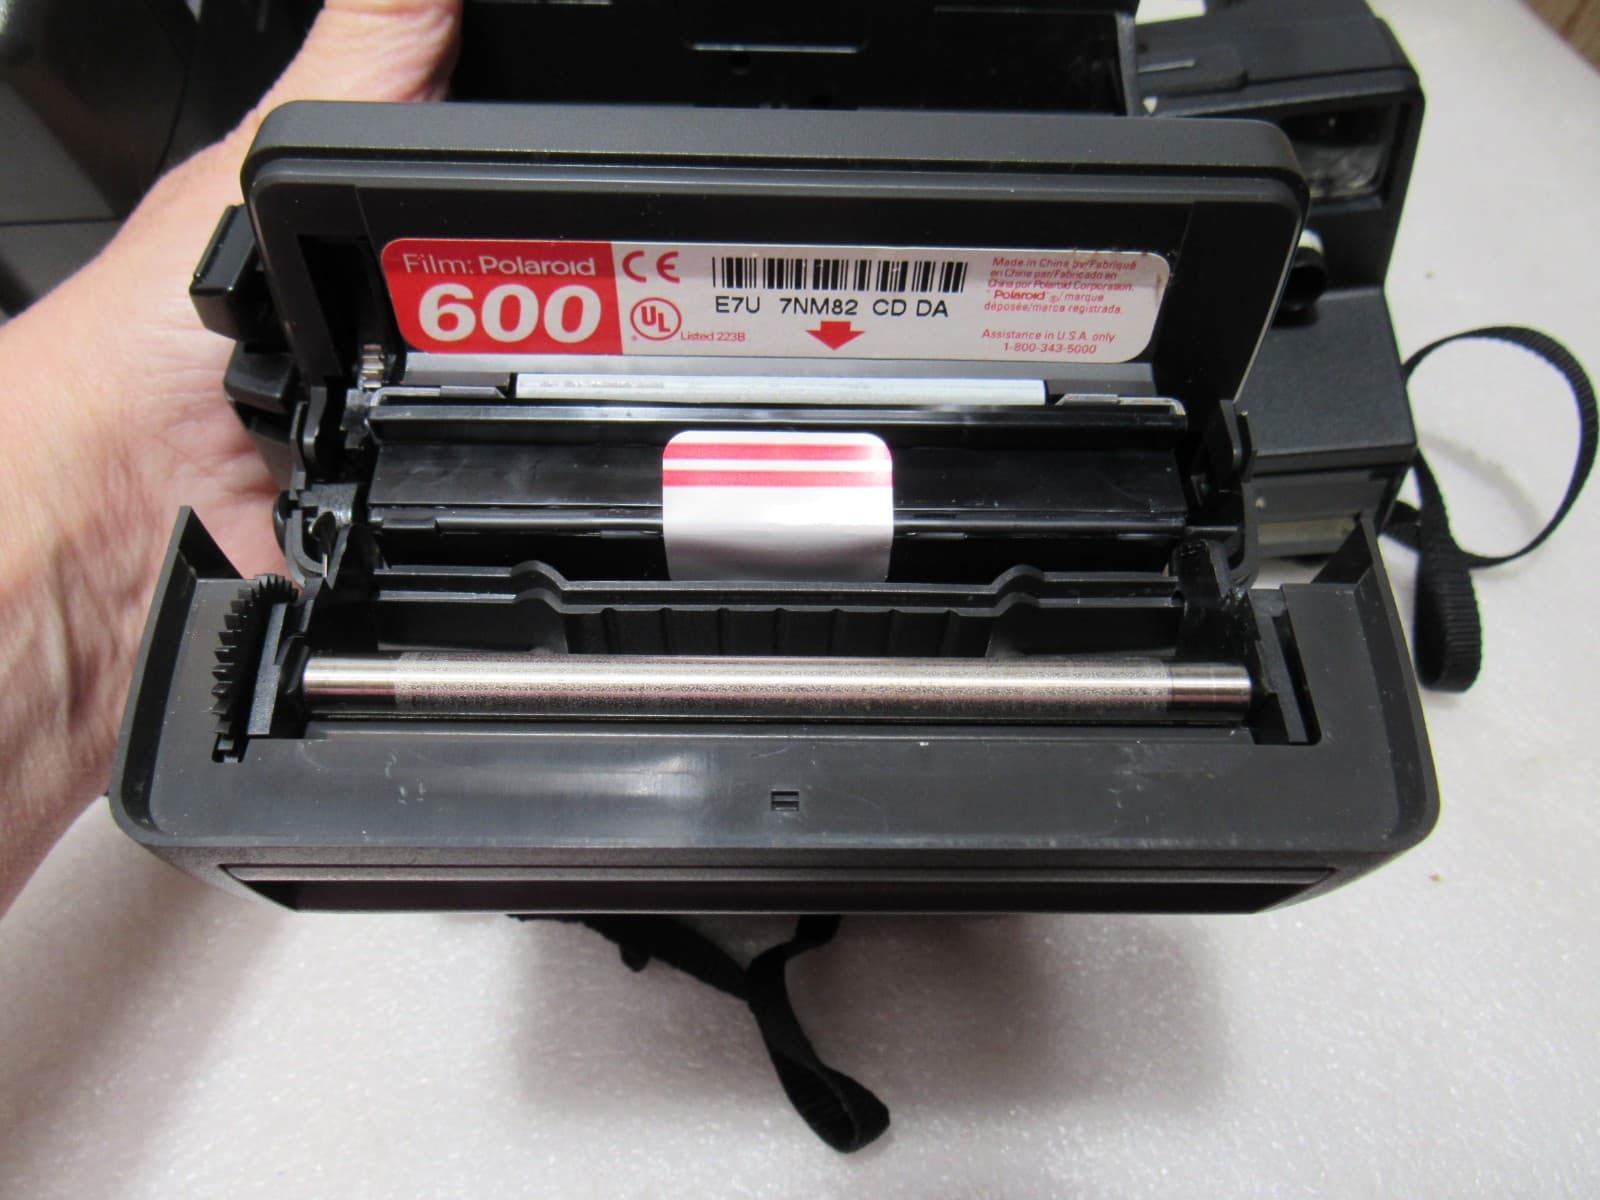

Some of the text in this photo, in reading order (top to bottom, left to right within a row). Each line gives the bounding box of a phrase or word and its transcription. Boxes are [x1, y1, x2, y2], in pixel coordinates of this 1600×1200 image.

[402, 253, 596, 276] Film: Polaroid
[992, 257, 1024, 267] Made
[1027, 259, 1036, 267] in
[1039, 258, 1069, 268] China
[1104, 272, 1118, 280] en
[1015, 281, 1032, 290] por
[1033, 280, 1071, 289] Polaroid
[1064, 293, 1105, 303] marque
[418, 282, 602, 344] 600
[715, 295, 949, 318] E7U 7NM82 CD DA
[641, 305, 671, 333] UL
[680, 331, 746, 342] Listed 223B
[982, 329, 1042, 340] Assistance
[1044, 330, 1054, 340] in
[1092, 333, 1116, 343] only
[1003, 342, 1097, 355] 1-800-343-5000
